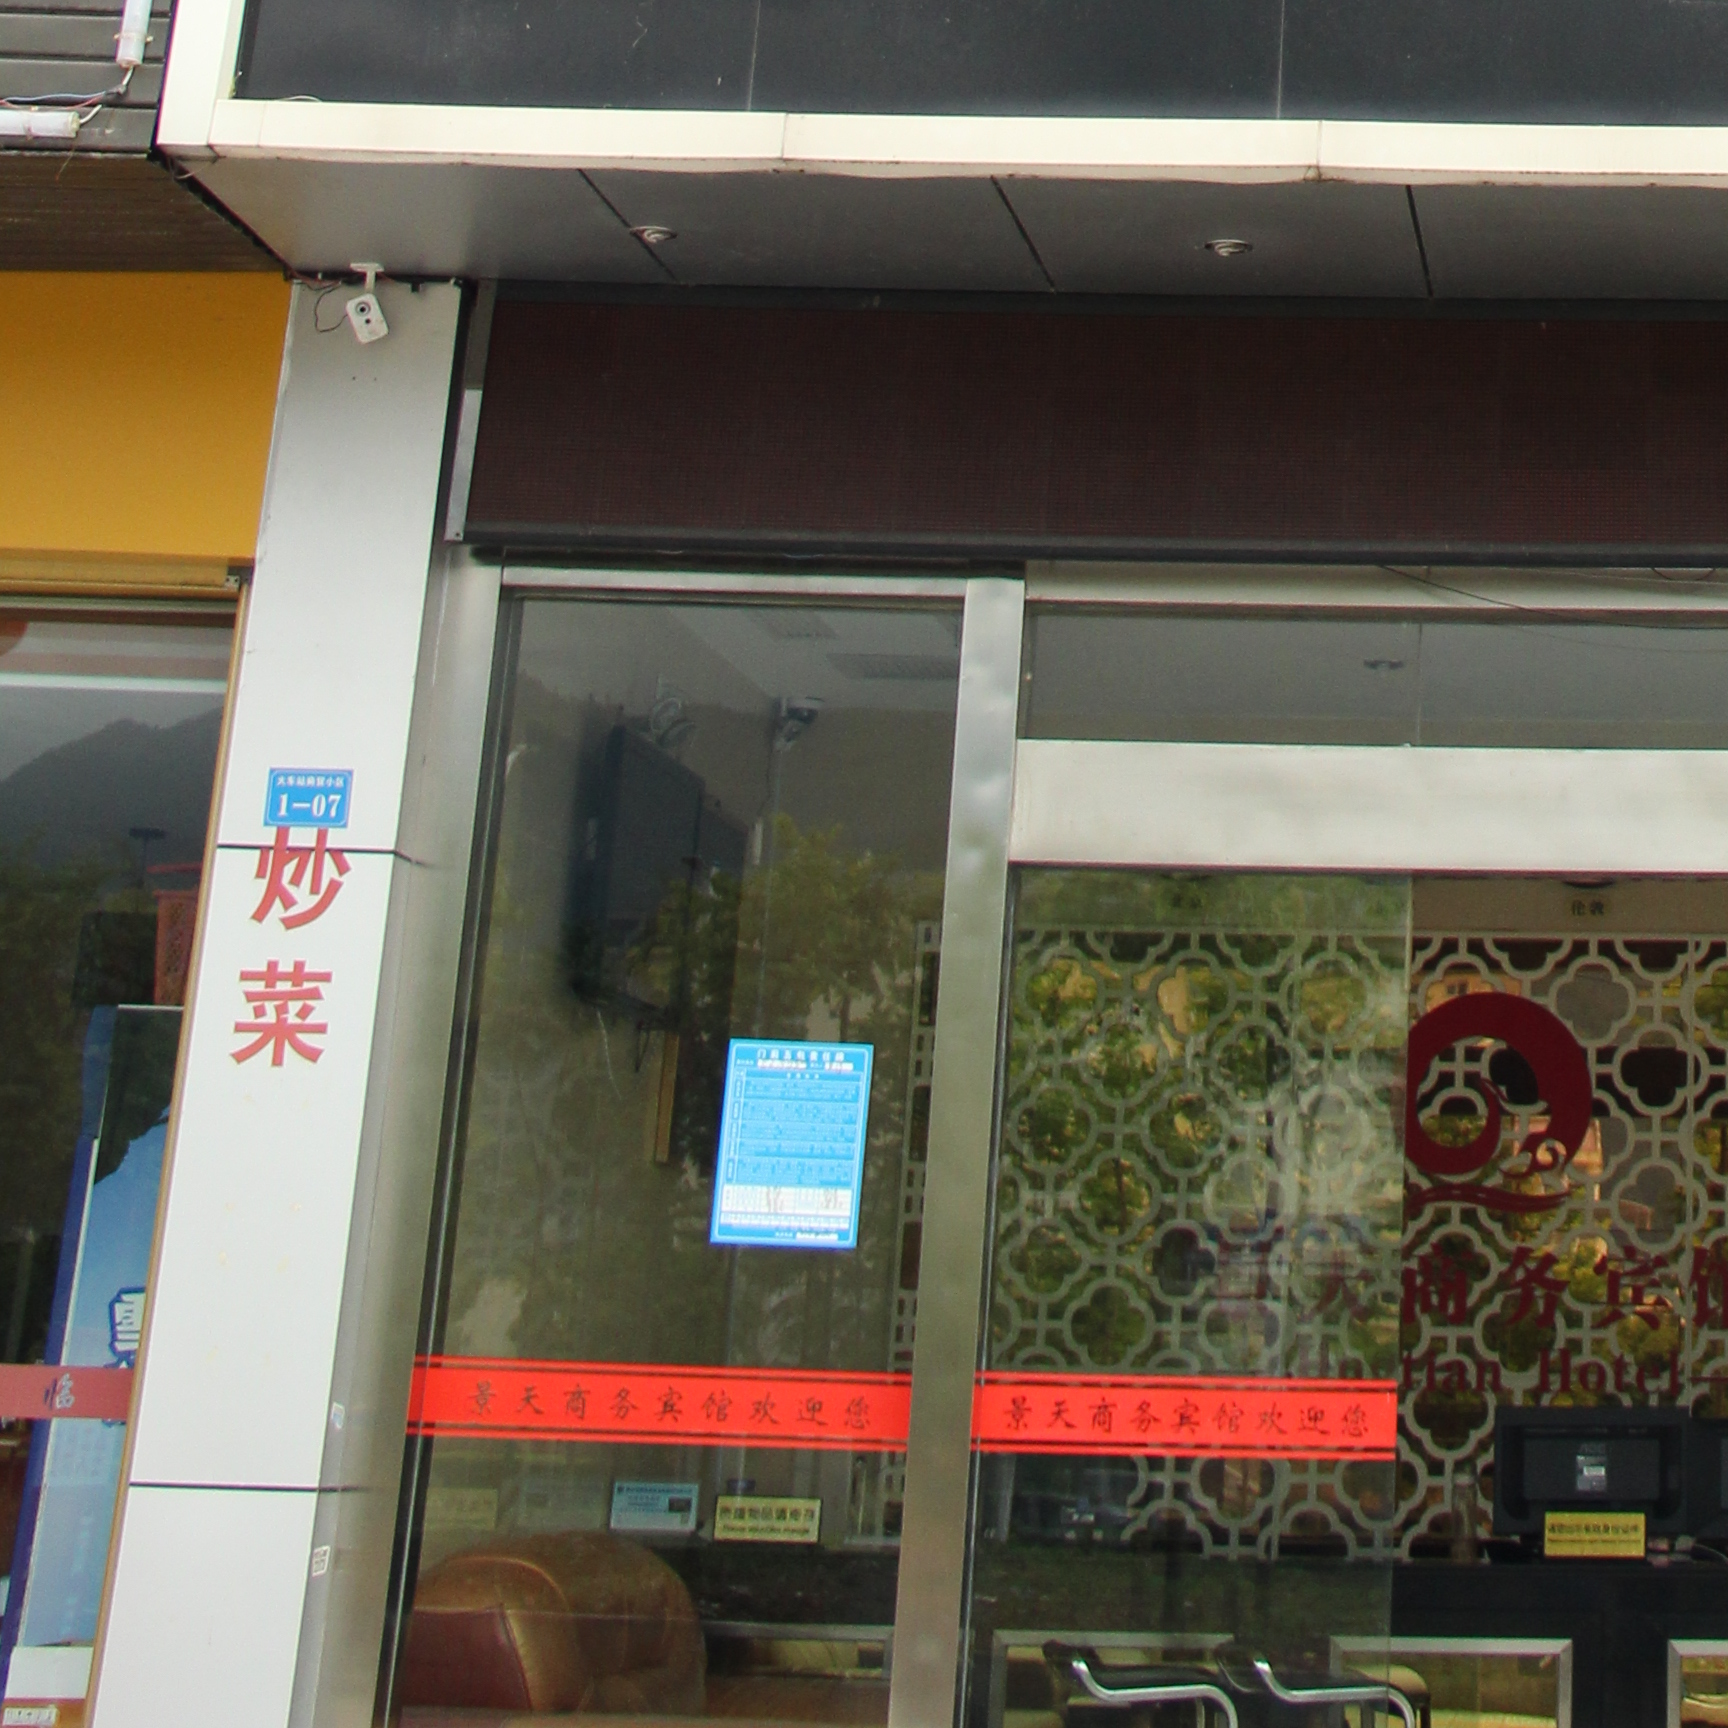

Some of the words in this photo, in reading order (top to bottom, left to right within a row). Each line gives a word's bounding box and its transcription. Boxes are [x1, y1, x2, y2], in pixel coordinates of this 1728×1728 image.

[231, 827, 351, 1068] 炒菜
[1539, 1347, 1681, 1396] Hotel
[466, 1378, 873, 1431] 景天商务宾馆欢迎您
[1000, 1394, 1372, 1441] 景天商务宾馆欢迎您
